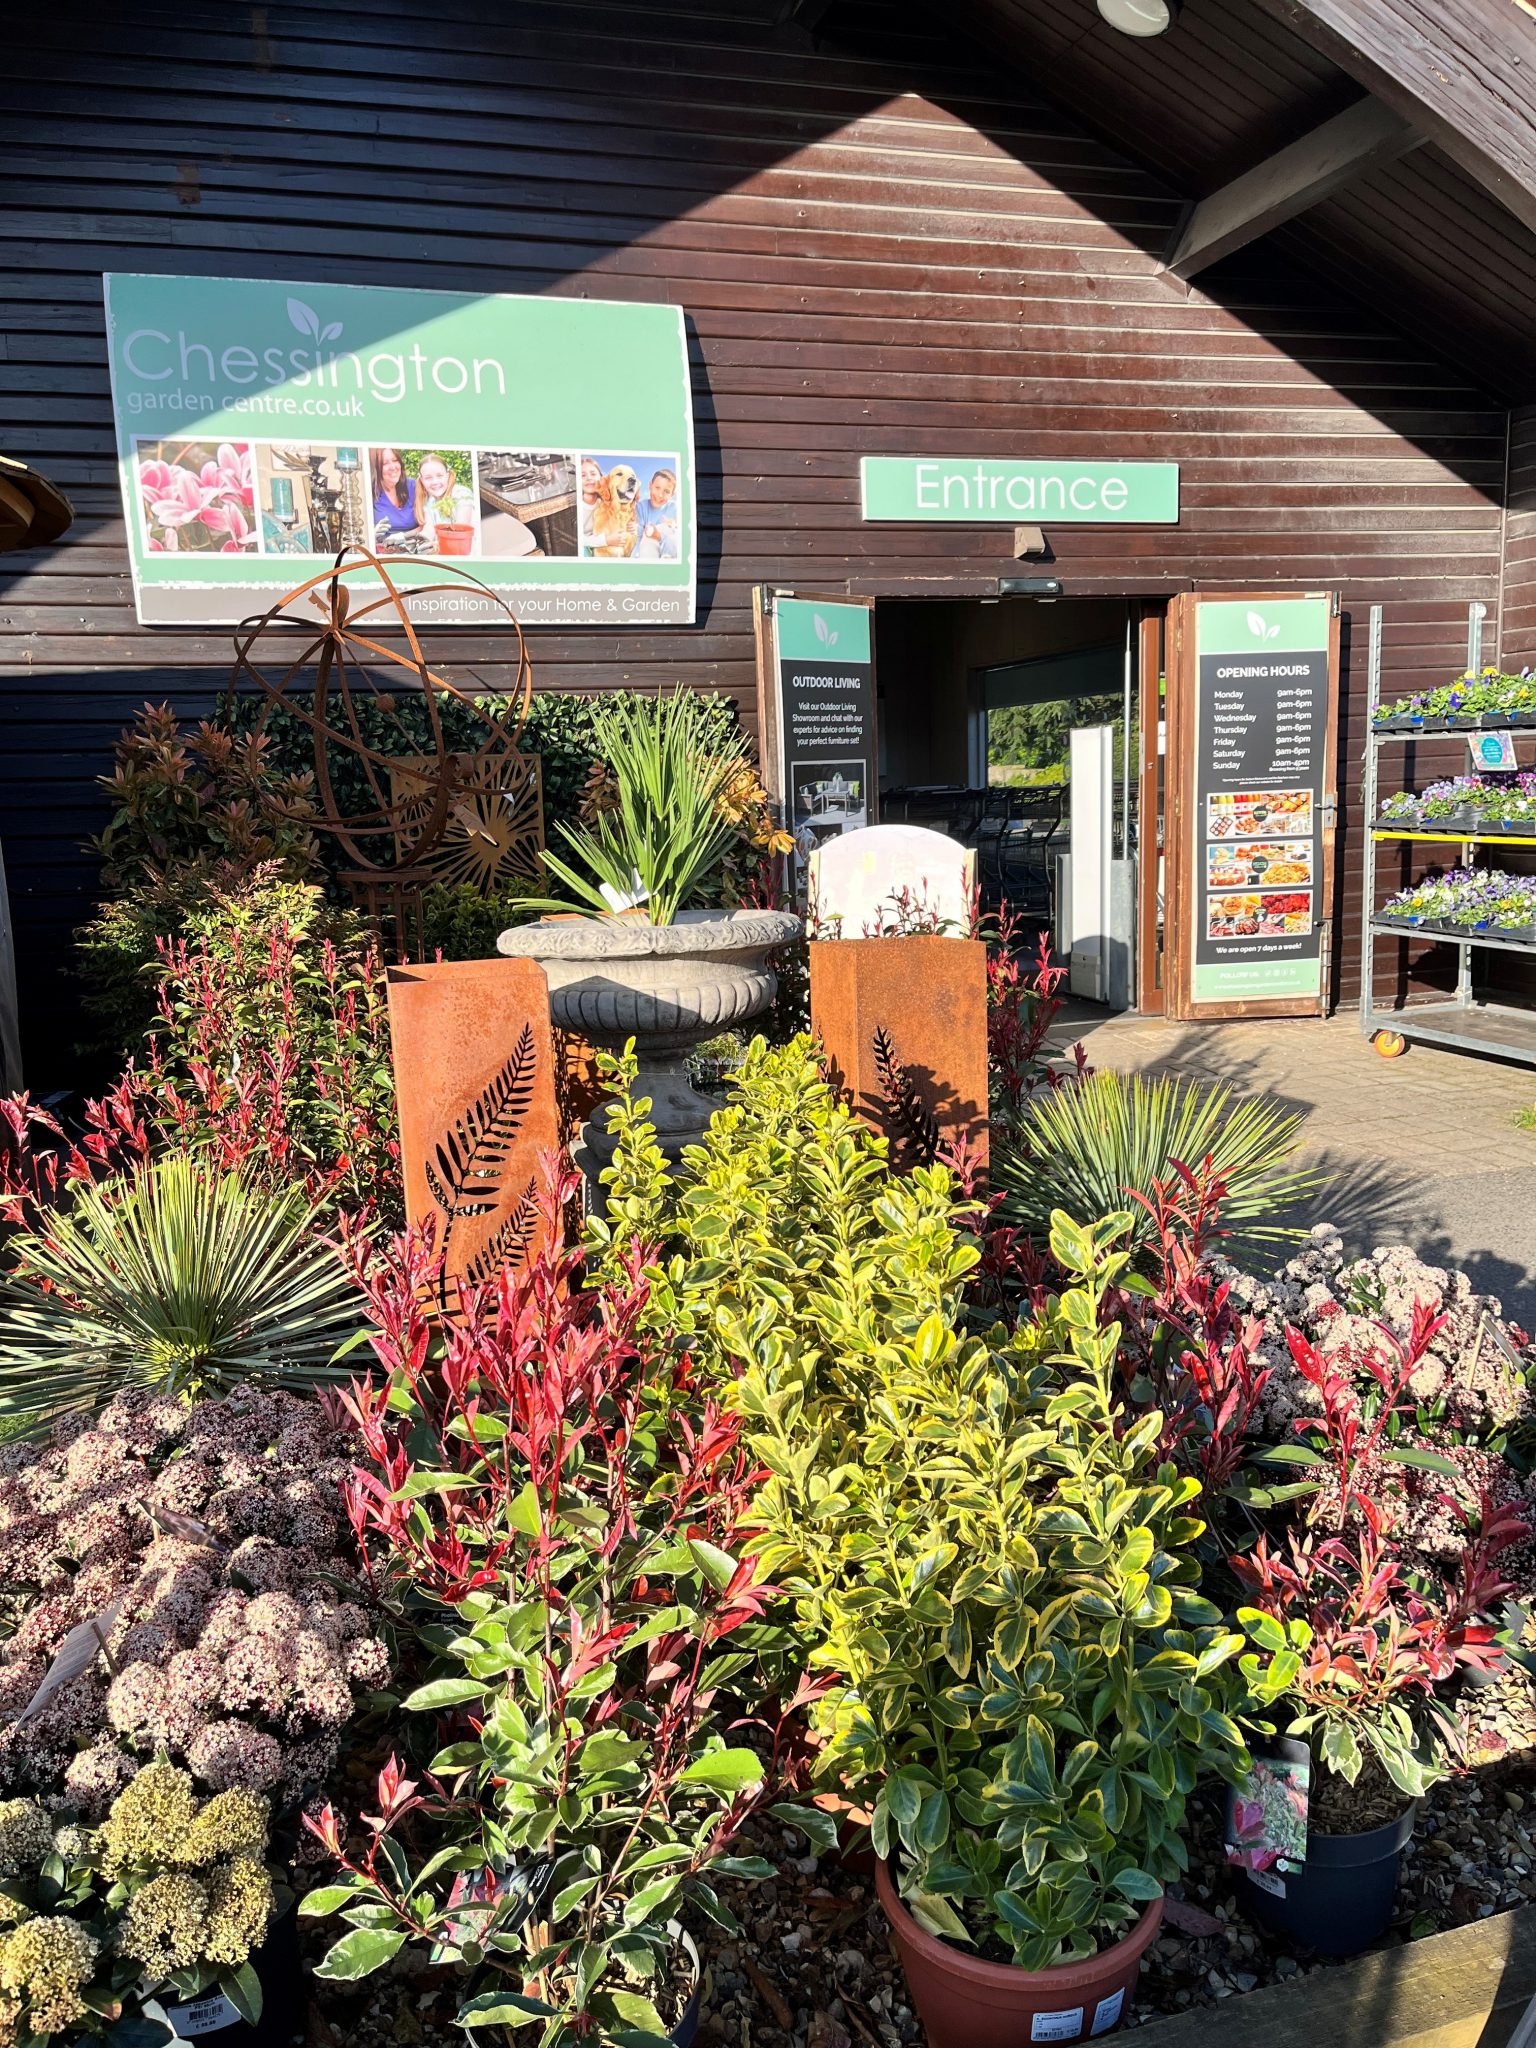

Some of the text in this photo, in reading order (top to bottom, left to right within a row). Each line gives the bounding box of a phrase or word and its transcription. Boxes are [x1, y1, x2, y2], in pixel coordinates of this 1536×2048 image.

[122, 329, 506, 403] Chessington
[127, 387, 365, 418] garden centre.co.uk
[915, 463, 1129, 511] Entrance
[408, 597, 680, 616] Inspiration for your Home & Garden
[1216, 665, 1310, 678] OPENING HOURS
[792, 675, 861, 689] OUTDOOR LIVING
[1214, 687, 1313, 699] Monday 9am-6pm
[798, 702, 857, 712] Visit our Outdoor Living
[1214, 700, 1312, 711] Tuesday 9am-6pm
[792, 714, 820, 722] Showroom
[821, 714, 831, 722] and
[831, 714, 843, 722] chat
[843, 714, 854, 722] with
[1214, 711, 1312, 722] Wednesday 9am-6pm
[793, 726, 813, 735] experts
[821, 725, 838, 733] advice
[845, 725, 863, 735] finding
[1213, 723, 1311, 734] Thursday 9am-6pm
[797, 738, 808, 747] your
[809, 738, 827, 747] perfect
[828, 736, 850, 745] furniture
[1213, 735, 1311, 746] Friday 9am-6pm
[1213, 747, 1310, 758] Saturday 9am-6pm
[1212, 759, 1310, 770] Sunday 10am-4pm
[1262, 944, 1278, 952] days
[1283, 942, 1302, 950] week!
